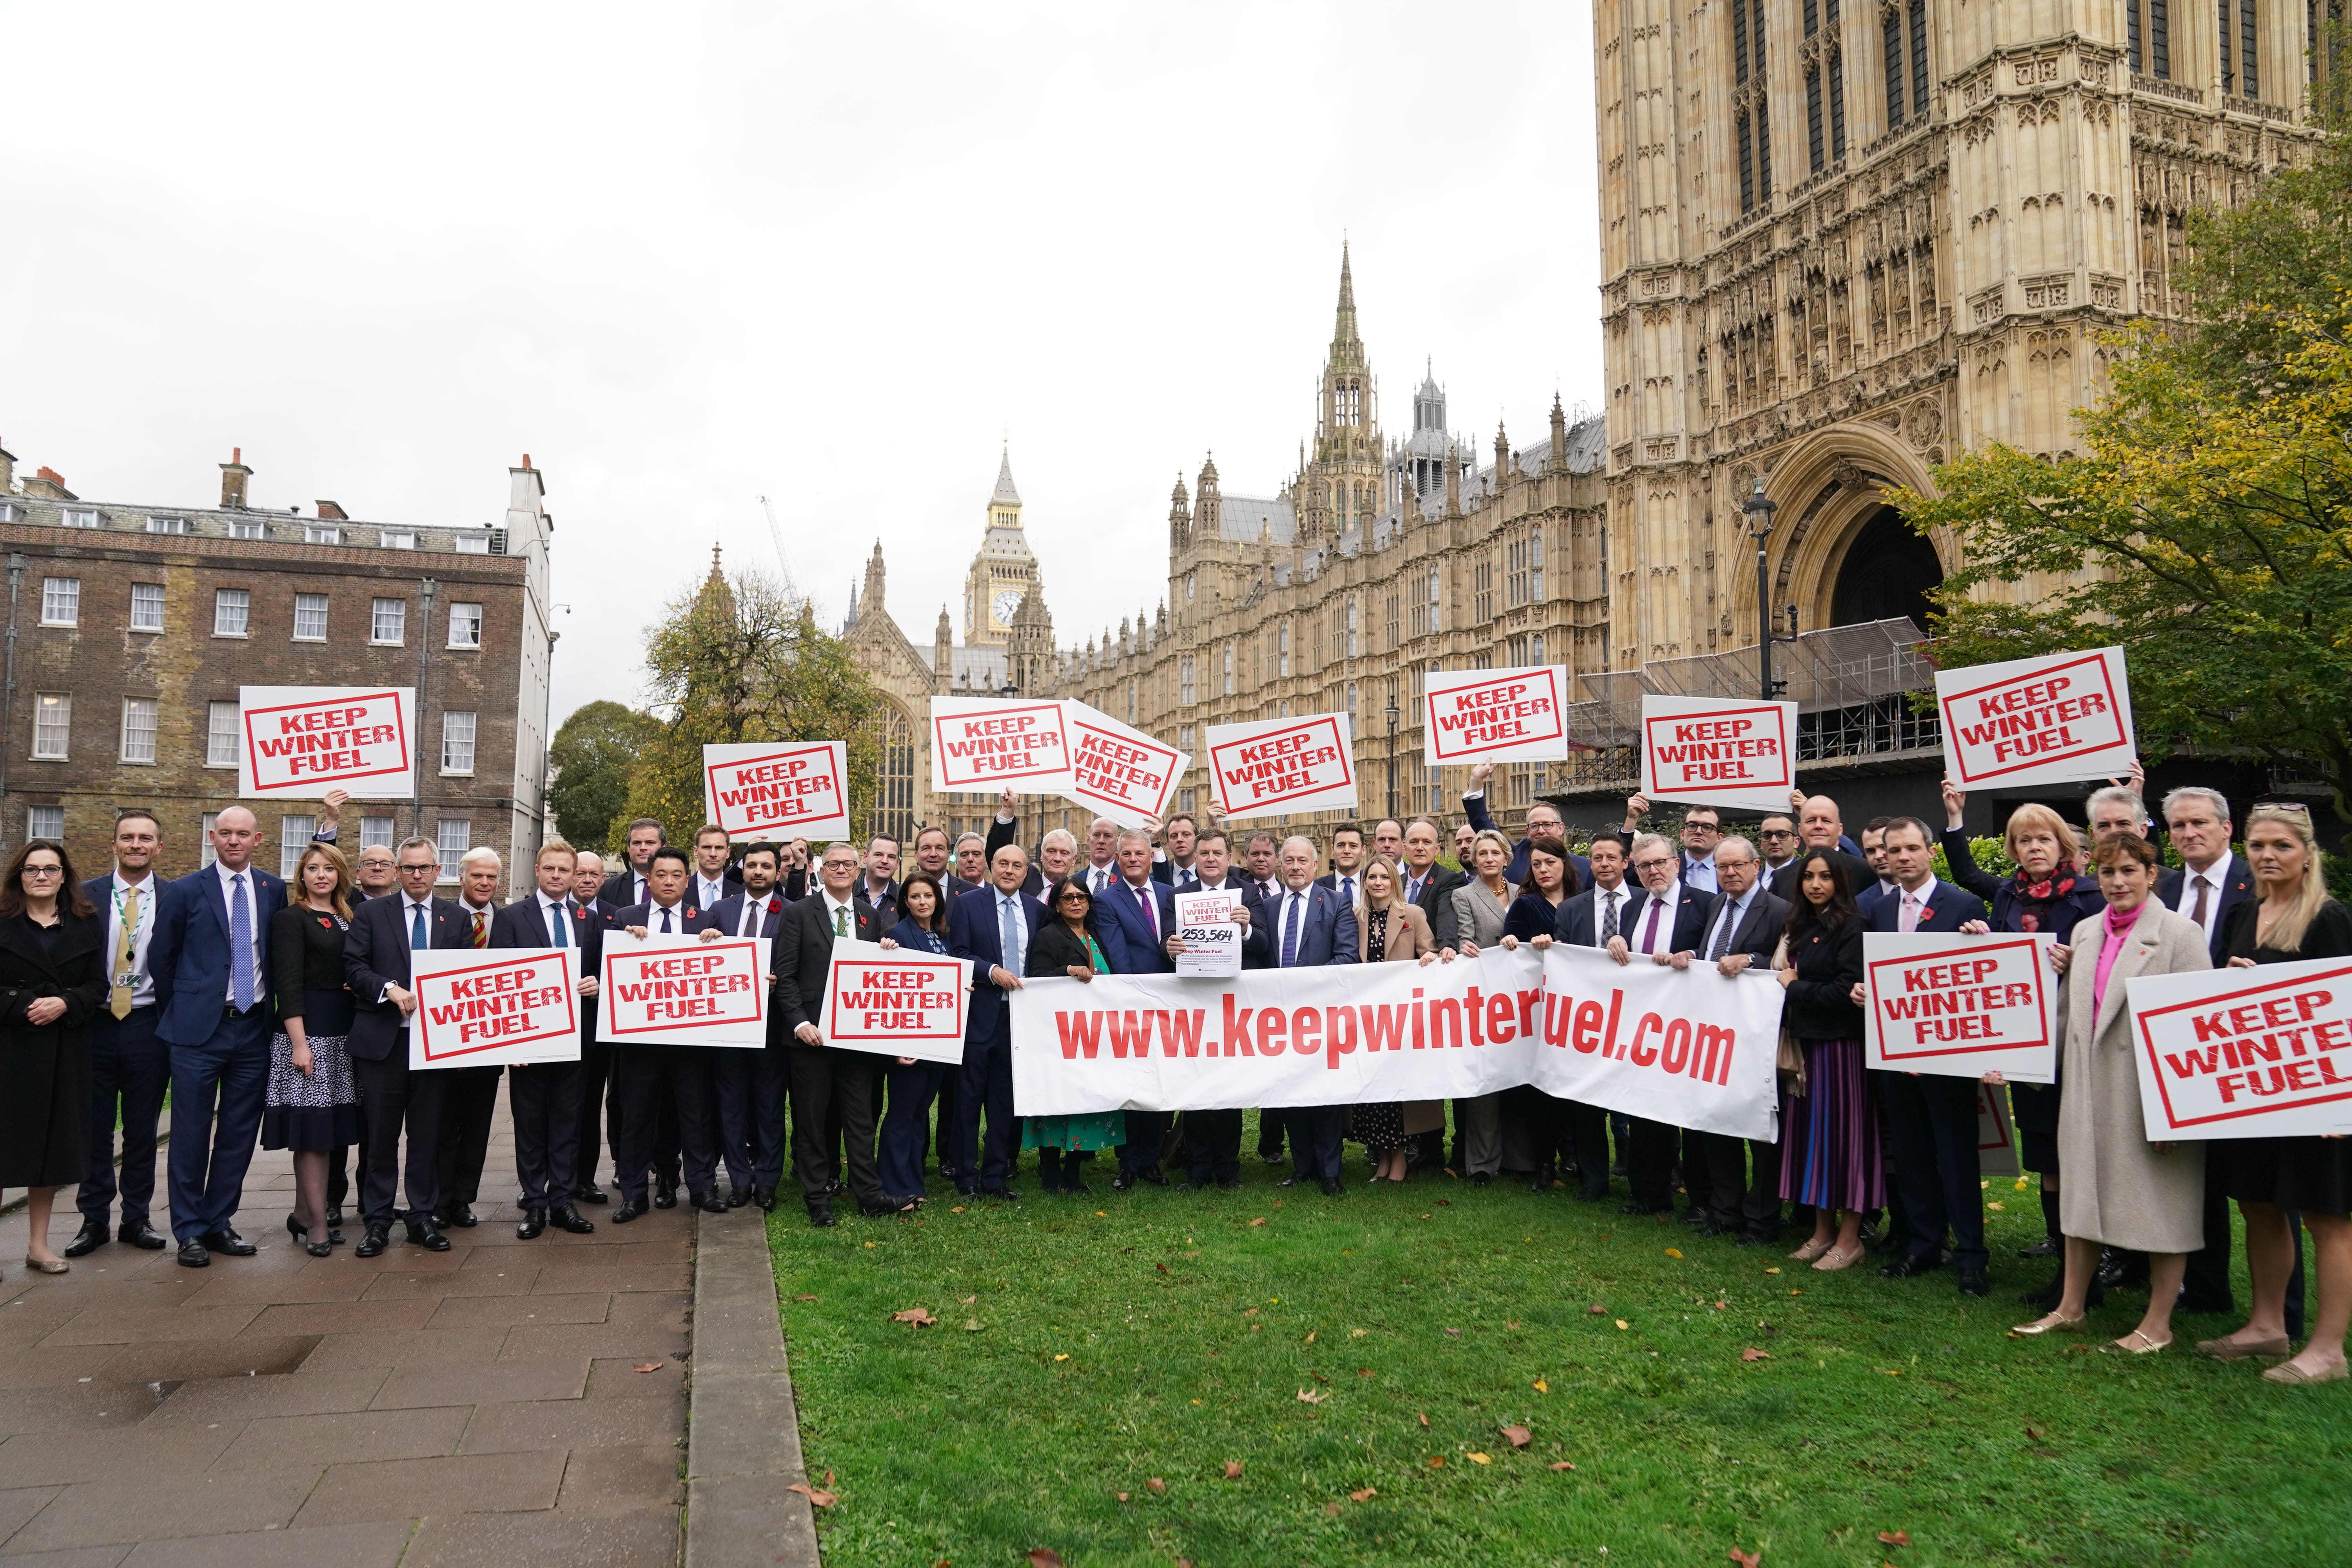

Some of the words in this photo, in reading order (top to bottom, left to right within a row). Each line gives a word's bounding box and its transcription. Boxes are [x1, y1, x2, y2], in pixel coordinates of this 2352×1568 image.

[1456, 684, 1526, 711] KEEP
[1979, 677, 2071, 719] KEEP
[280, 707, 367, 734] KEEP
[964, 717, 1035, 738] KEEP
[1439, 698, 1550, 731] WINTER
[1960, 693, 2107, 746] WINTER
[258, 725, 395, 757] WINTER
[947, 731, 1059, 757] WINTER
[1464, 720, 1530, 745] FUEL
[1675, 720, 1752, 742] KEEP
[1994, 726, 2082, 763] FUEL
[289, 750, 370, 775] FUEL
[973, 752, 1040, 773] FUEL
[1081, 734, 1149, 764] KEEP
[1240, 734, 1311, 764] KEEP
[1657, 738, 1777, 763] WINTER
[736, 760, 807, 786] KEEP
[1225, 746, 1336, 785] WINTER
[1682, 761, 1754, 782] FUEL
[720, 775, 831, 807] WINTER
[1075, 767, 1132, 800] FUEL
[1252, 770, 1319, 798] FUEL
[746, 798, 812, 822] FUEL
[1186, 907, 1228, 915] WINTER
[1181, 929, 1233, 943] 253,564
[640, 956, 724, 980] KEEP
[862, 971, 935, 989] KEEP
[1904, 959, 1998, 992] KEEP
[451, 969, 536, 1000] KEEP
[617, 974, 750, 1002] WINTER
[429, 986, 562, 1025] WINTER
[646, 998, 725, 1021] FUEL
[841, 992, 953, 1009] WINTER
[1883, 983, 2033, 1020] WINTER
[460, 1013, 539, 1043] FUEL
[864, 1012, 931, 1029] FUEL
[1055, 975, 1735, 1086] www.keepwinteruel.com
[1915, 1014, 2003, 1044] FUEL
[2192, 991, 2333, 1042] KEEP
[2164, 1018, 2352, 1079] WINTE
[2216, 1057, 2352, 1103] FUEL
